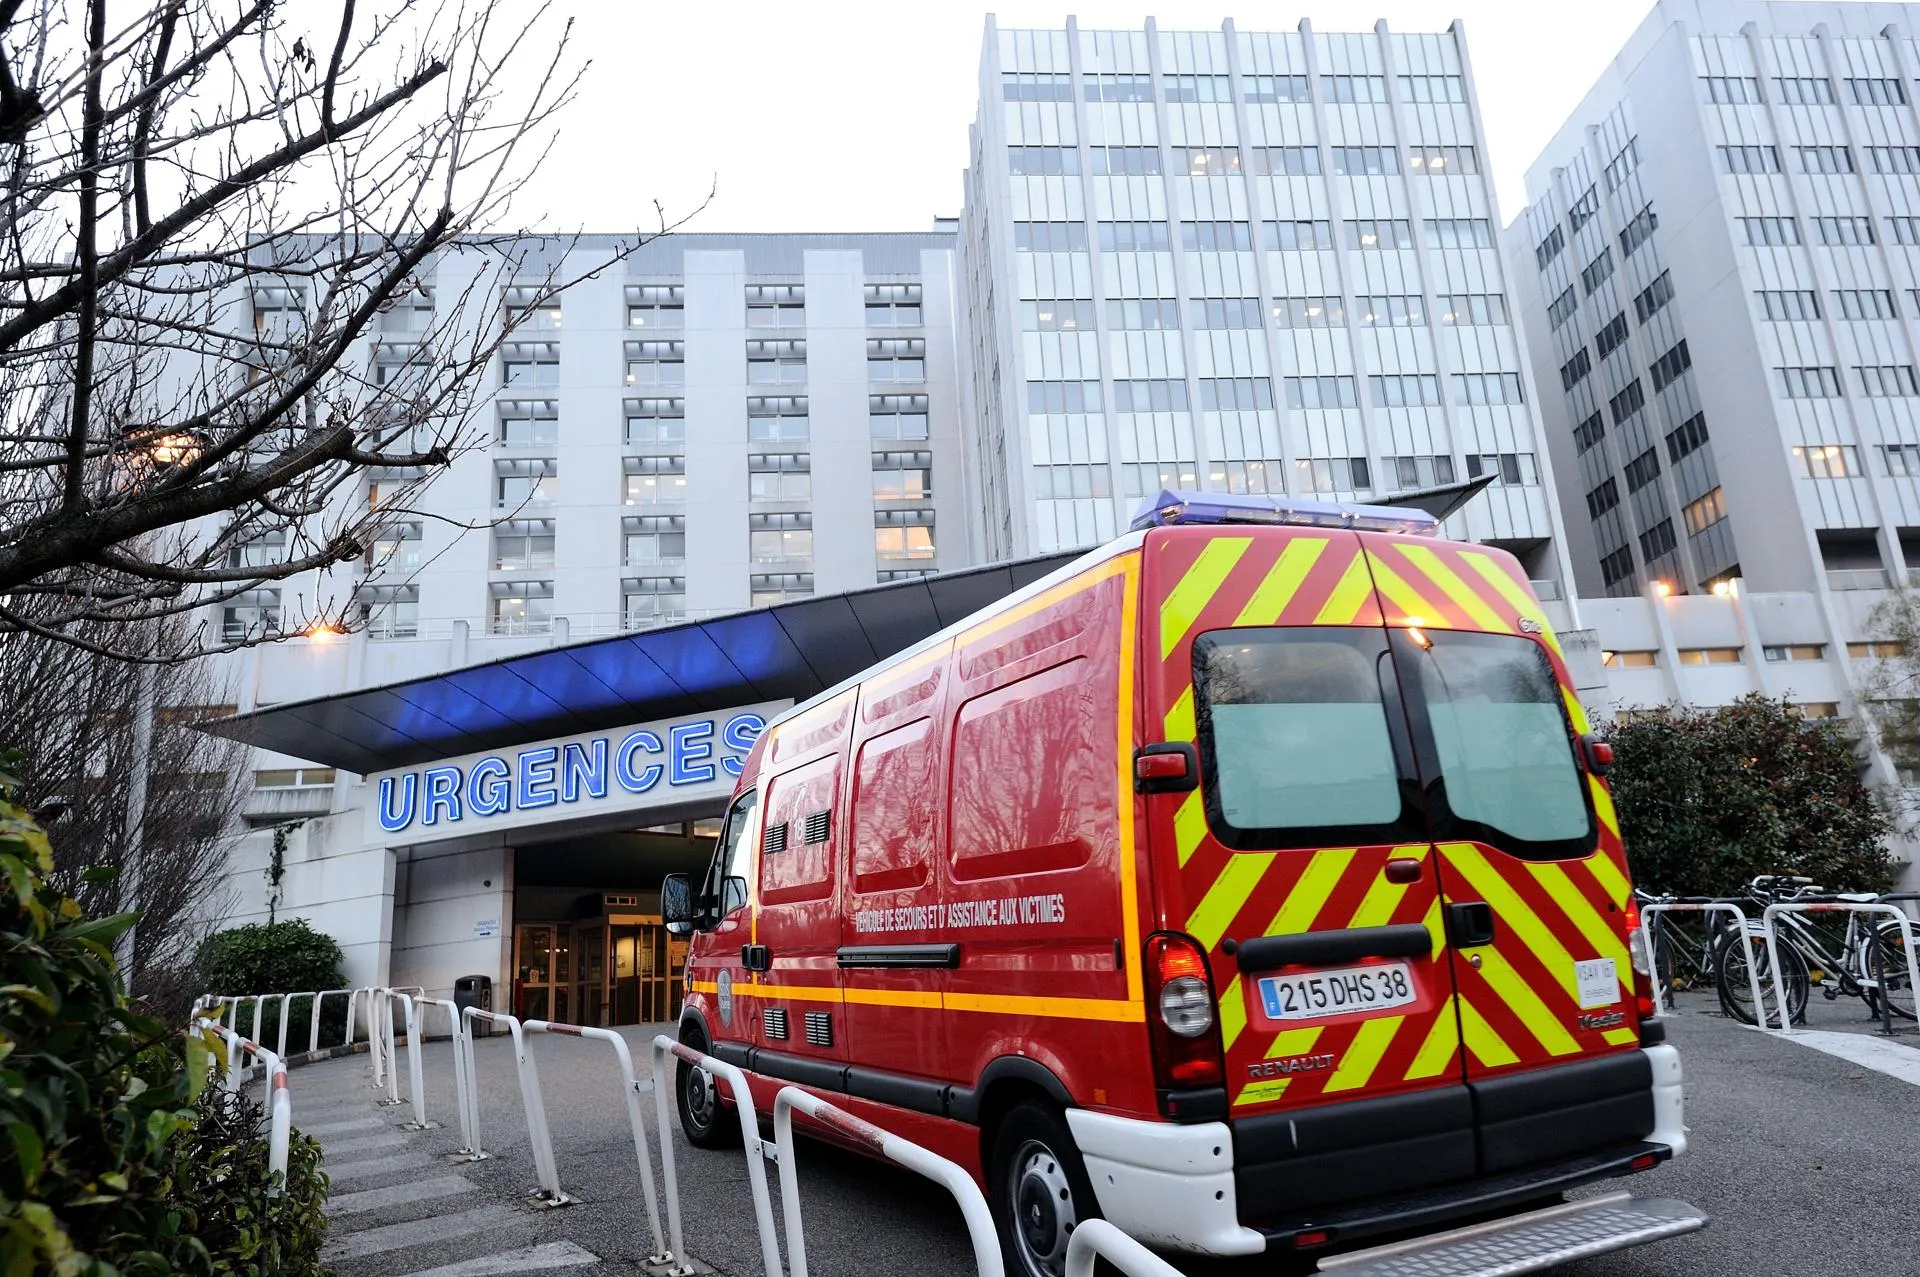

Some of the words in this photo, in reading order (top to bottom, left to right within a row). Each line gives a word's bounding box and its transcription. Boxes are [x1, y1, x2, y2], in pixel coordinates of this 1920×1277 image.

[377, 714, 765, 832] URGENCES
[885, 909, 895, 931] DE
[895, 905, 927, 931] SECOURS
[928, 904, 938, 929] ET
[948, 900, 997, 928] ASSISTANCE
[999, 898, 1018, 925] AUX
[1019, 893, 1065, 923] VICTIMES
[1280, 979, 1327, 1012] 215
[1329, 974, 1375, 1005] DHS
[1378, 969, 1408, 999] 38
[1247, 1054, 1335, 1078] RENAULT
